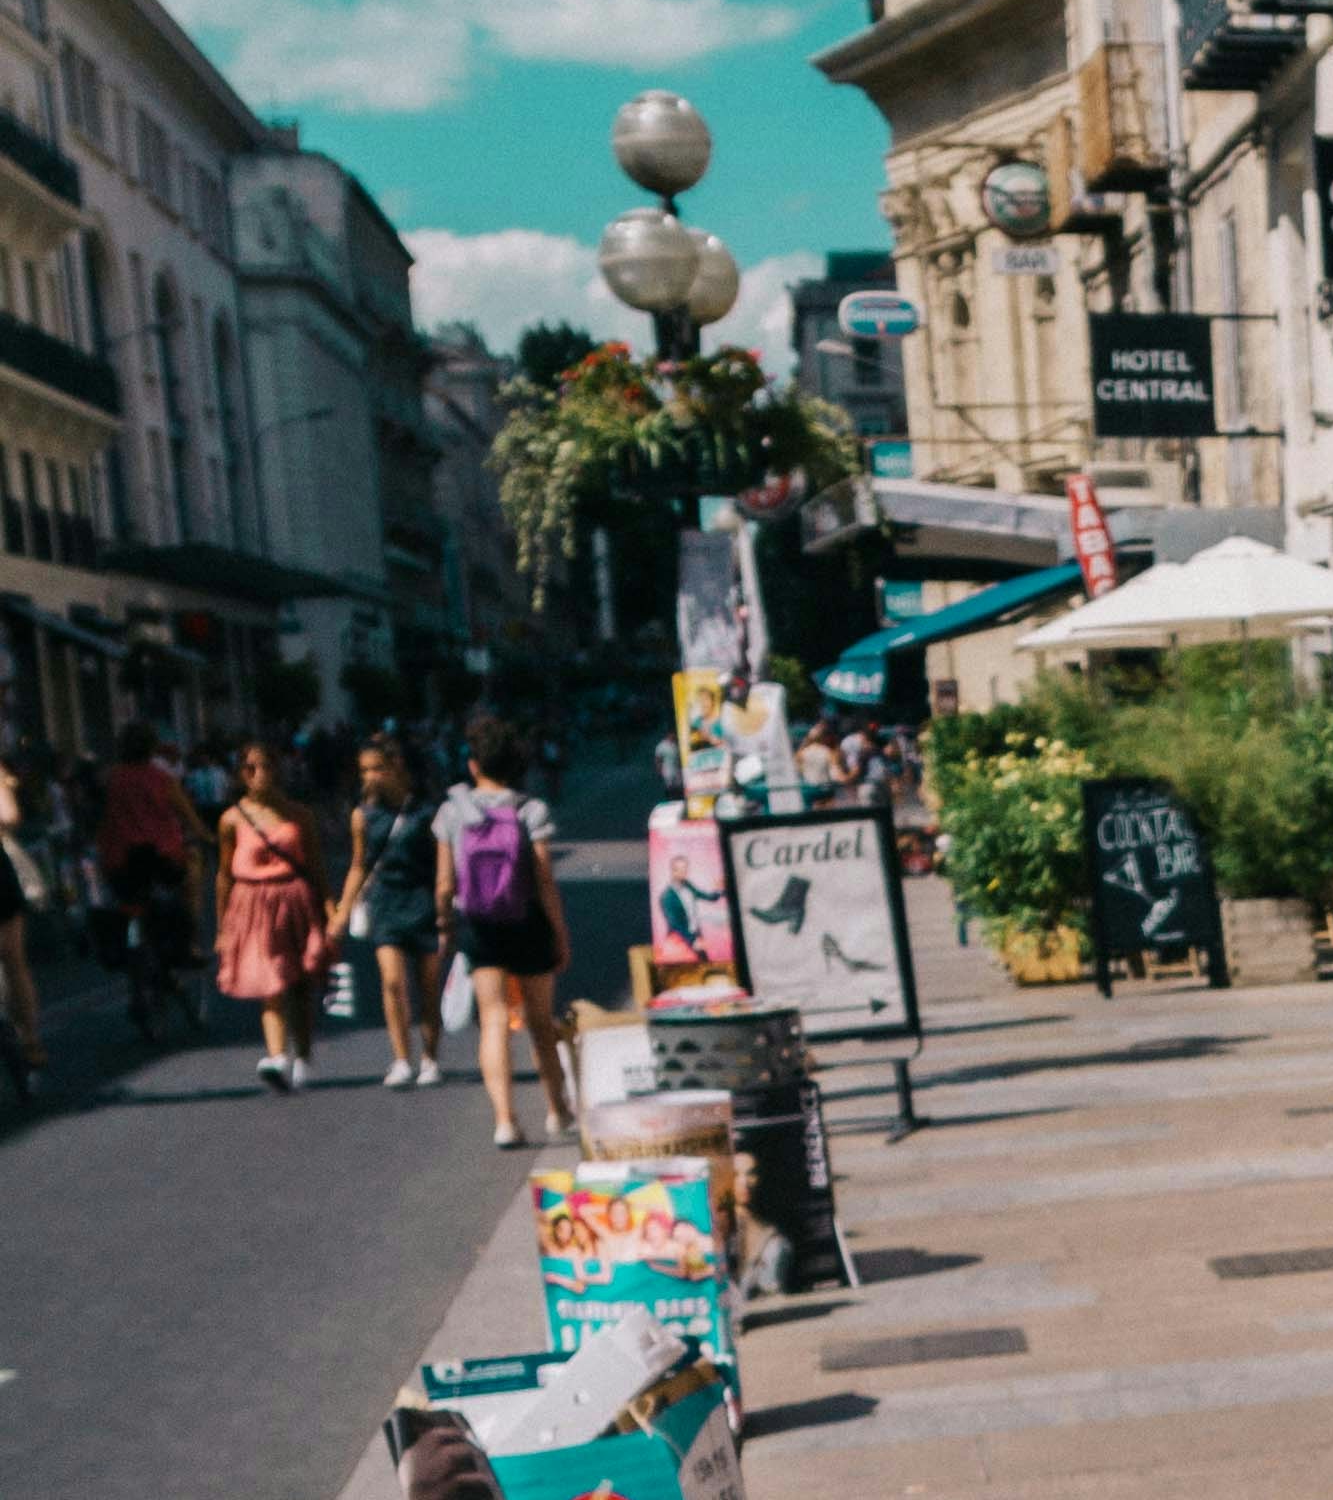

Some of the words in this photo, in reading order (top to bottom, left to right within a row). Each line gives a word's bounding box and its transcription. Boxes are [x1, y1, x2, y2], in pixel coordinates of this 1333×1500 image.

[1111, 350, 1193, 373] HOTEL
[1096, 379, 1210, 401] CENTRAL
[745, 827, 866, 870] Cardel
[1155, 844, 1201, 880] BAR
